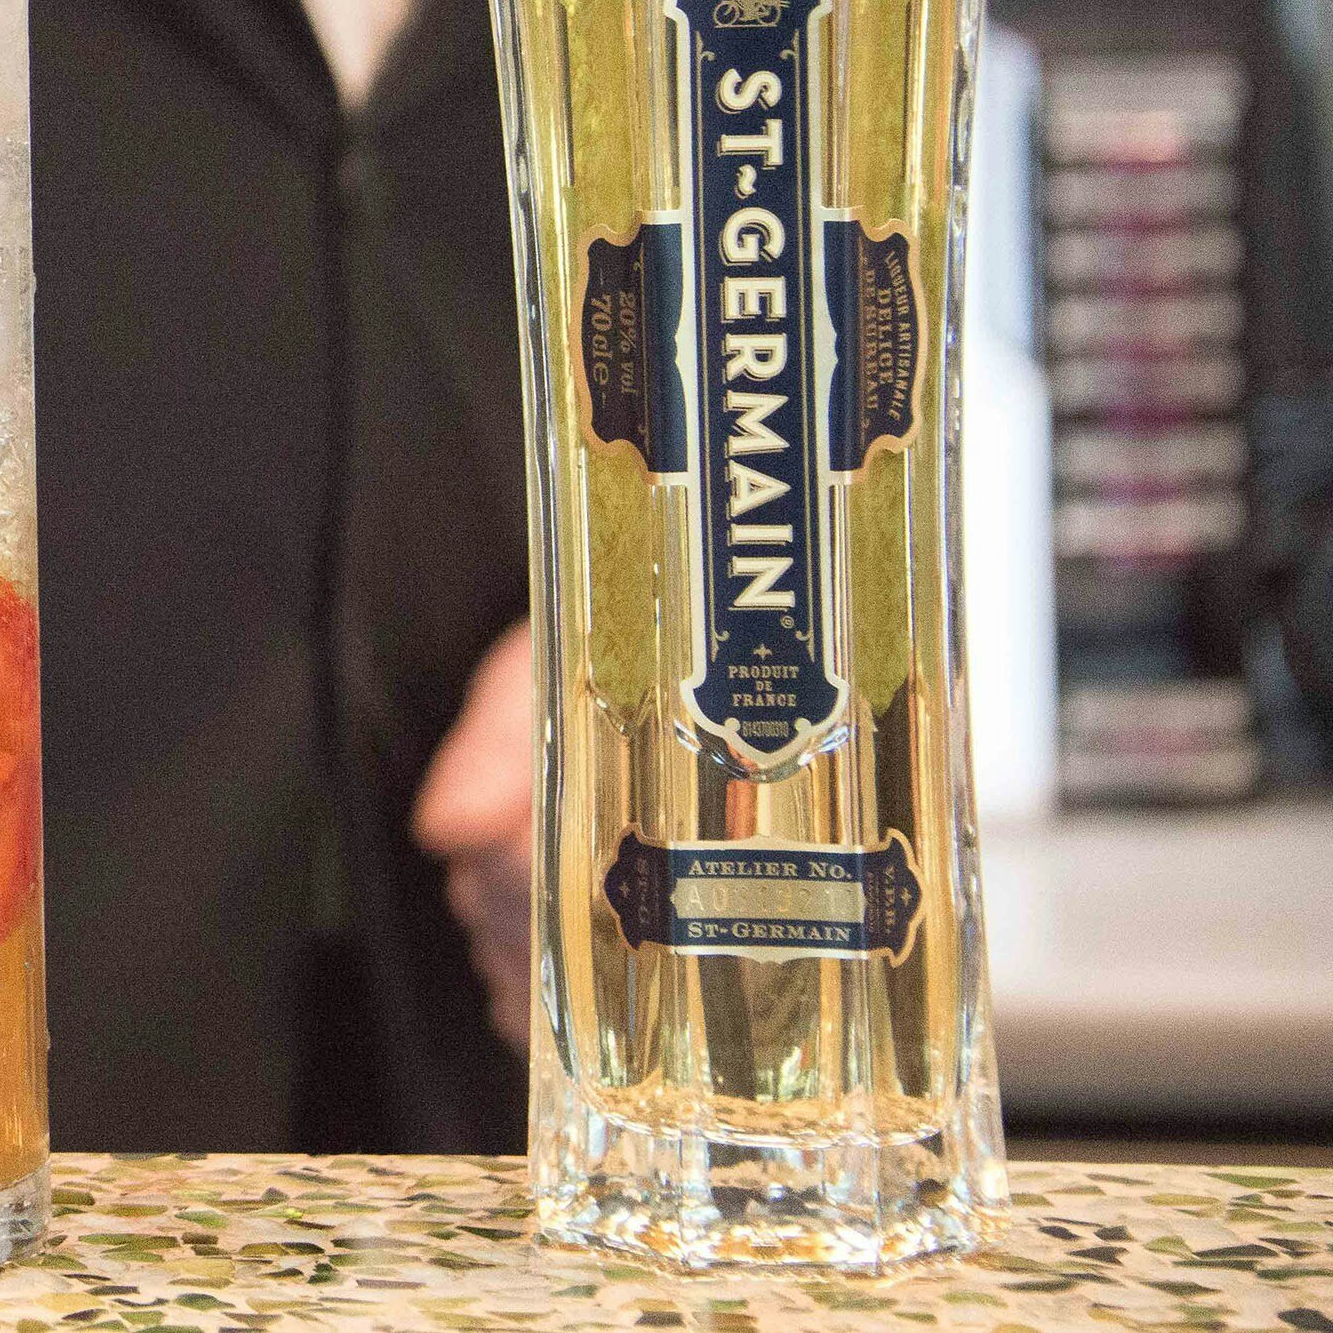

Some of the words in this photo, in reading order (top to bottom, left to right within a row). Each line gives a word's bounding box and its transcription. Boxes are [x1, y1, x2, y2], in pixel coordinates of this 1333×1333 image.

[884, 250, 910, 316] LIQUEUR
[887, 321, 912, 422] ARTISANALE
[728, 665, 800, 679] PRODUIT
[755, 681, 773, 692] DE
[732, 693, 797, 708] FRANCE
